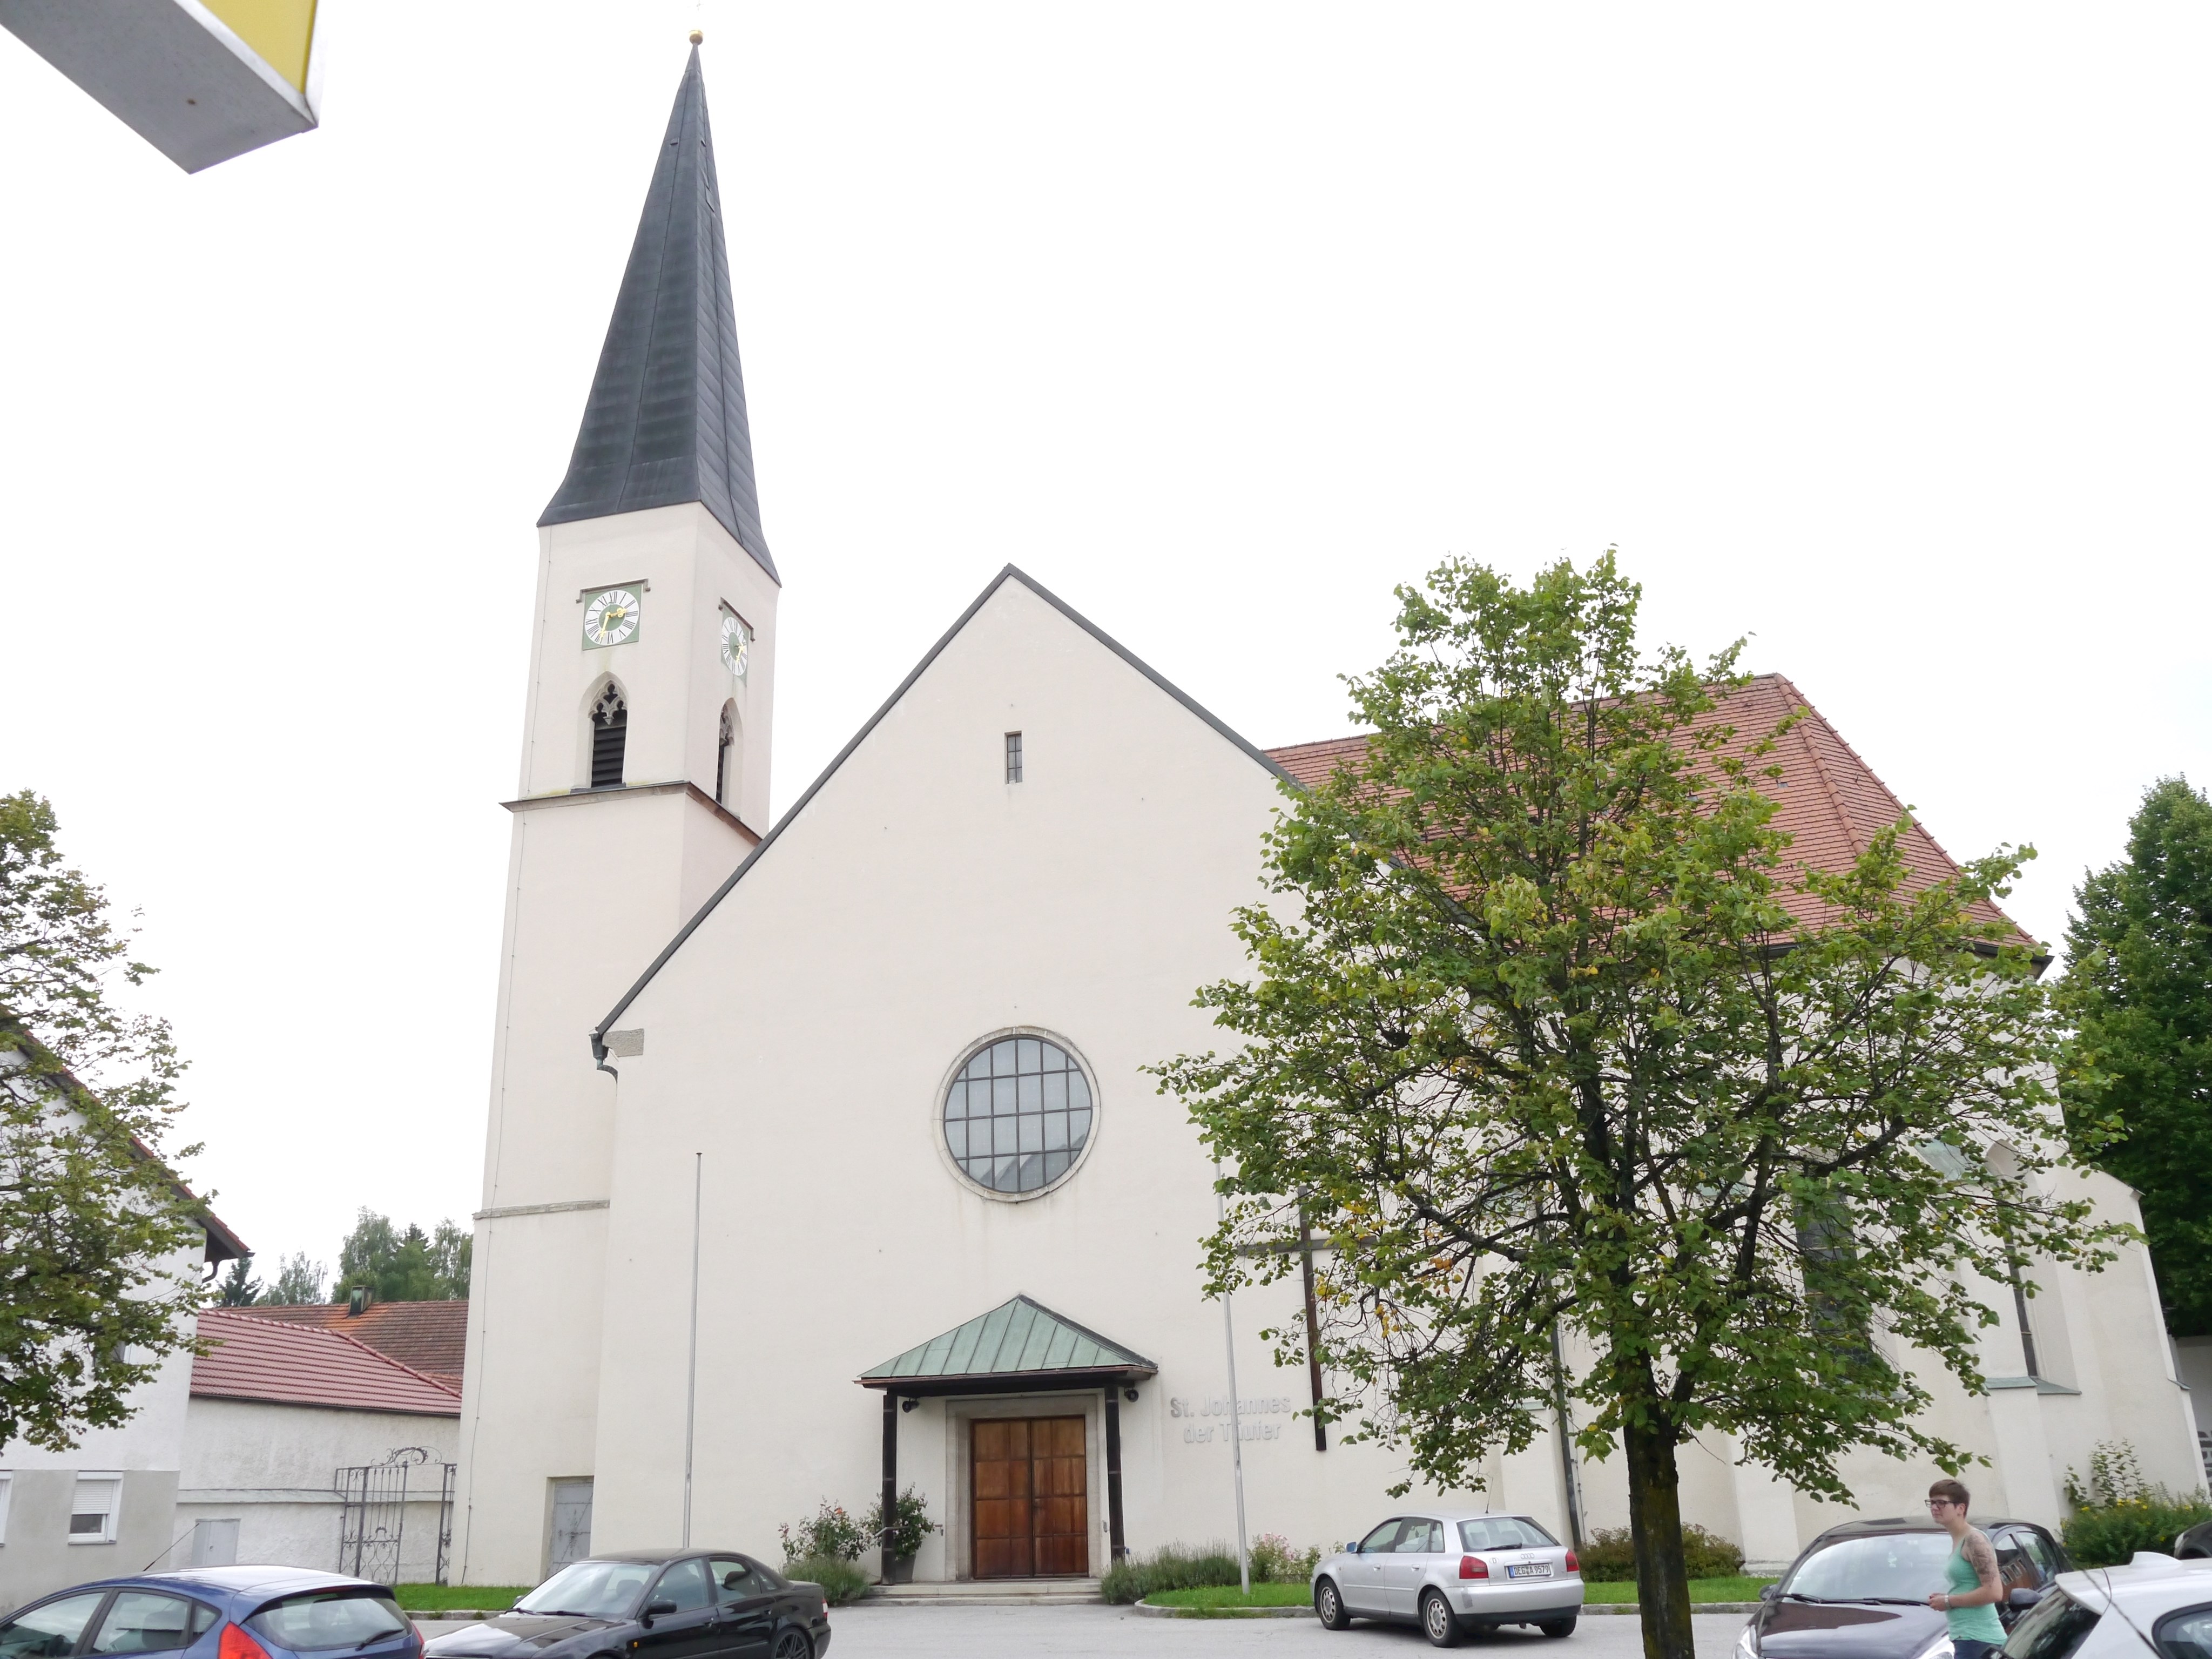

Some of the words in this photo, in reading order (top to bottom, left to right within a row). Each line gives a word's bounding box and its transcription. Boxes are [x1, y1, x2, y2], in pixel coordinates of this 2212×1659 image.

[1170, 1397, 1195, 1418] St.
[1200, 1394, 1291, 1417] Johannes
[1183, 1424, 1214, 1444] der
[1514, 1566, 1526, 1575] DEG
[1534, 1564, 1549, 1573] 9579
